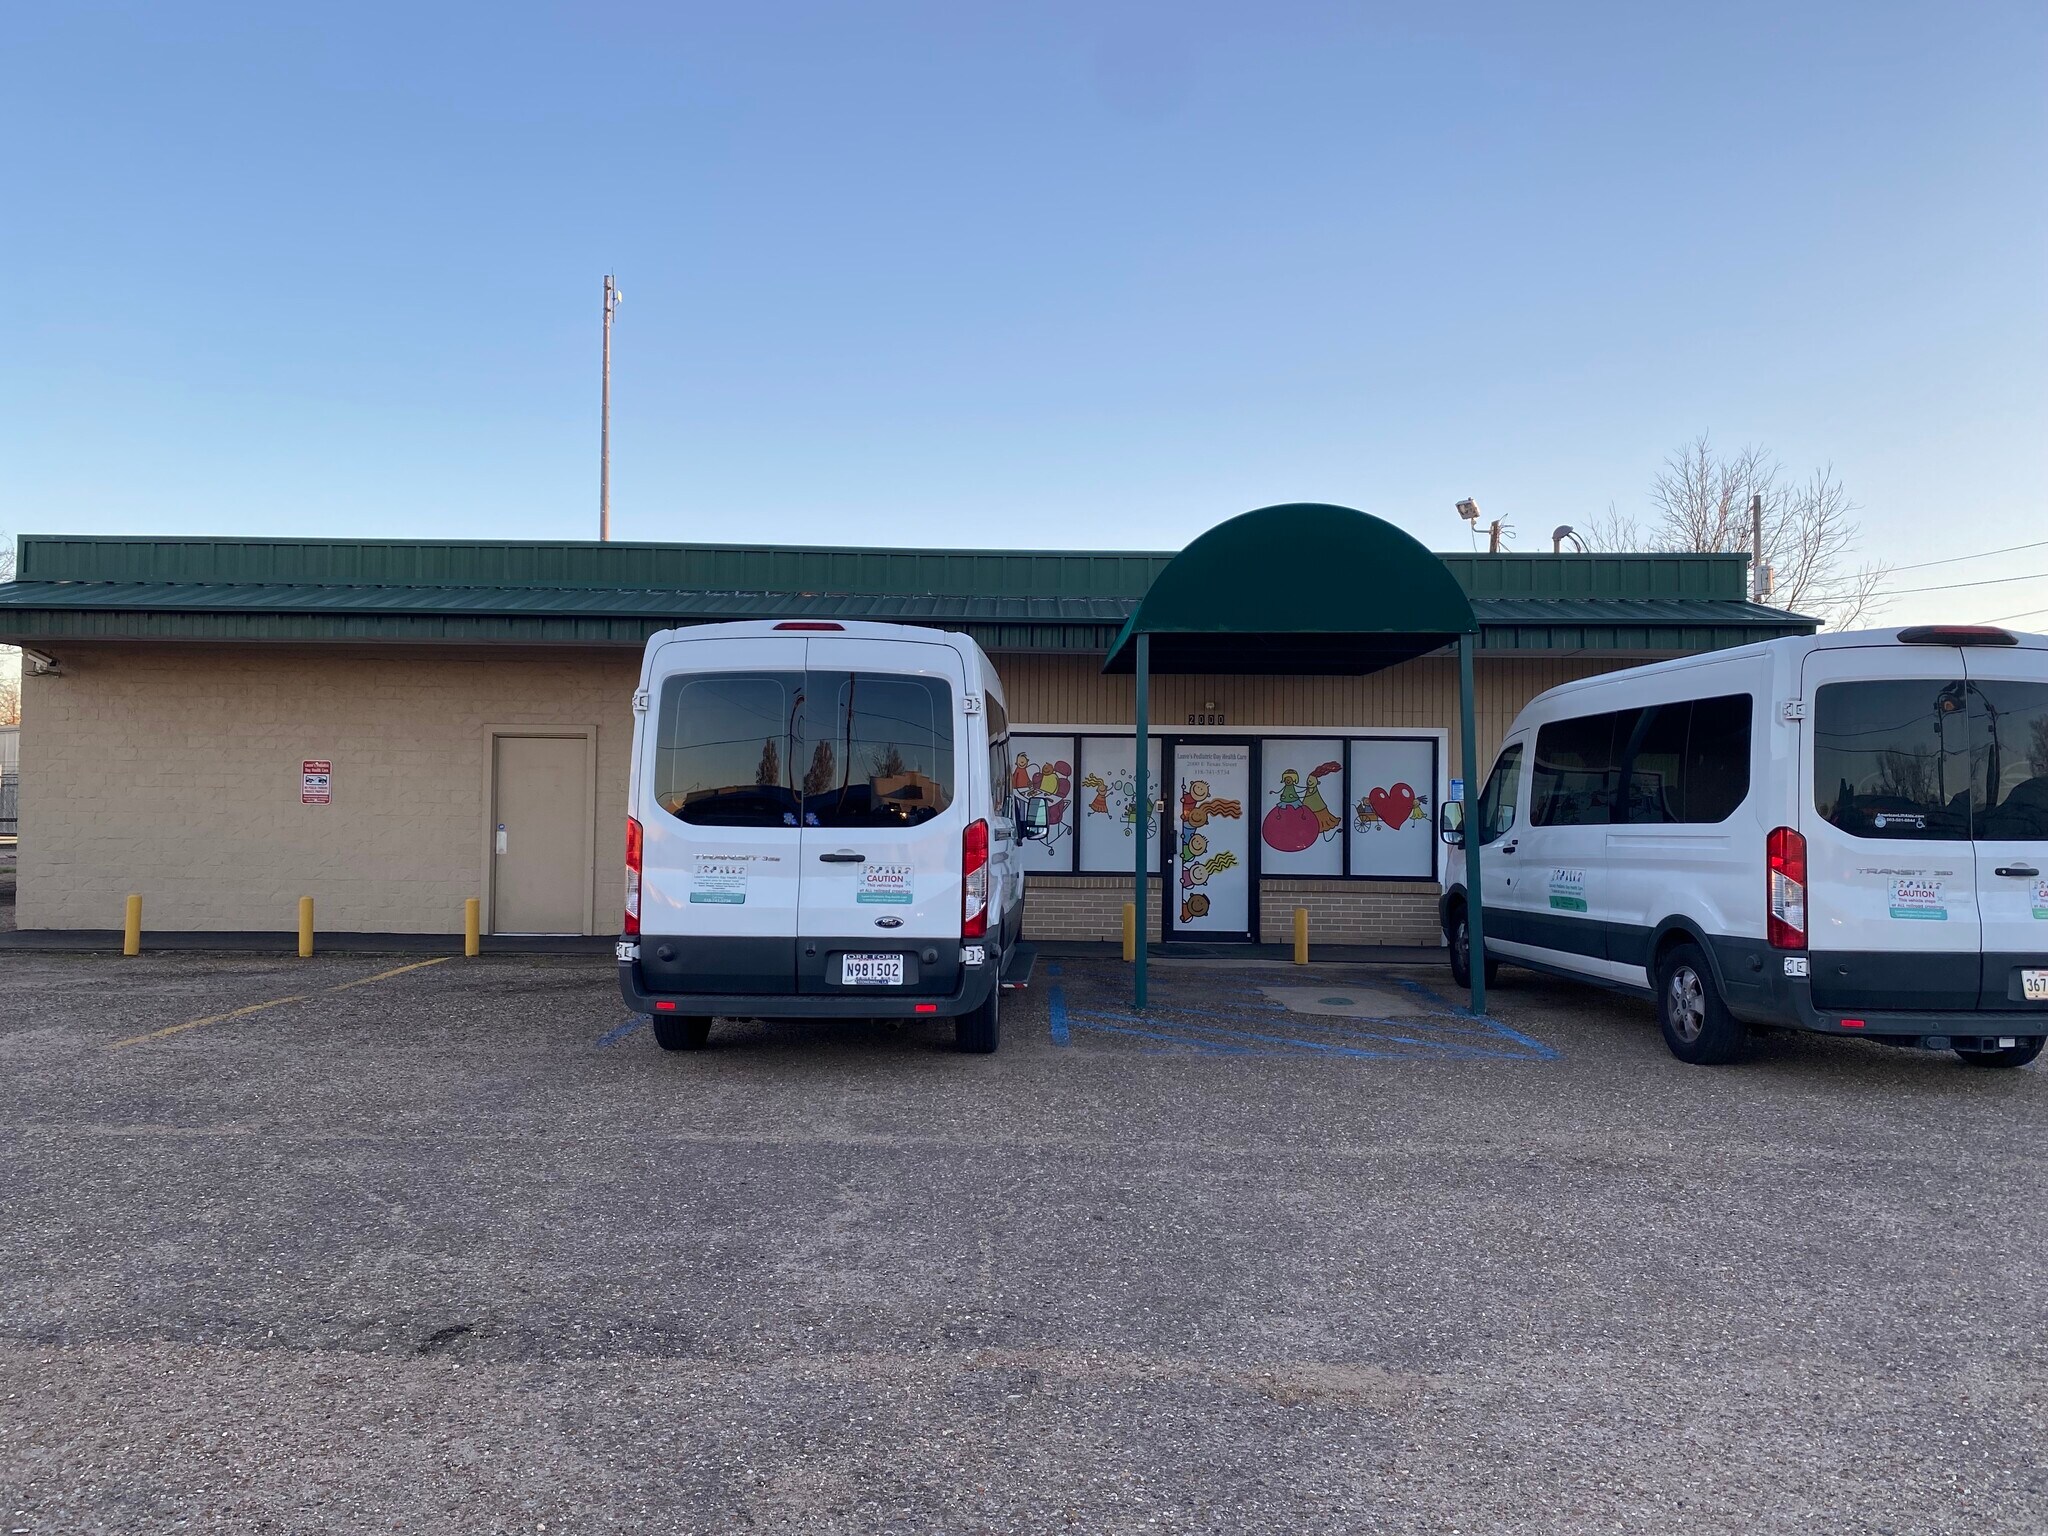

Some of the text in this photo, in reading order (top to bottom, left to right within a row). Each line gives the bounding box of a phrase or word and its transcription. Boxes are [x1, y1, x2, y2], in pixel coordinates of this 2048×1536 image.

[1189, 715, 1224, 725] 2000
[1213, 753, 1221, 761] Day
[693, 853, 758, 861] TRANSIT
[1856, 868, 1926, 876] TRANSIT
[867, 875, 904, 883] CAUTION
[1897, 889, 1935, 898] CAUTION
[847, 963, 899, 976] N981502
[2026, 978, 2047, 992] 367
